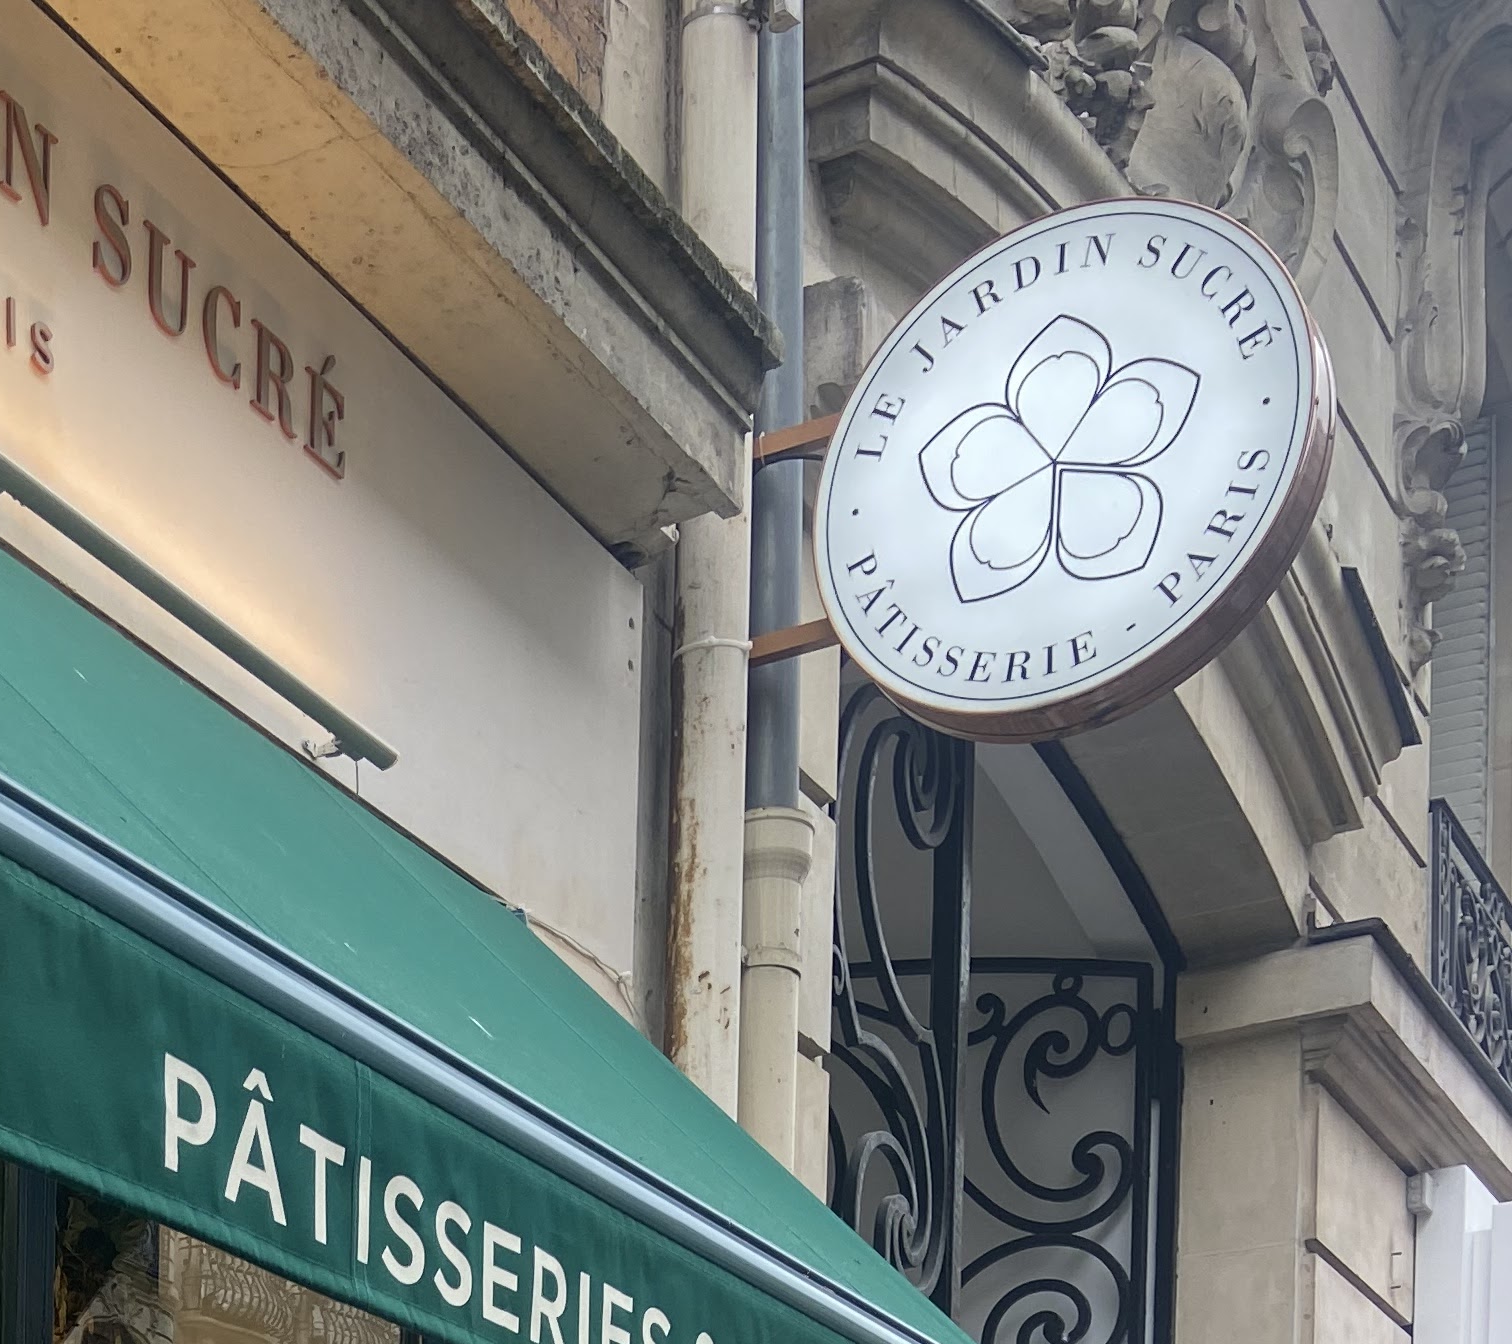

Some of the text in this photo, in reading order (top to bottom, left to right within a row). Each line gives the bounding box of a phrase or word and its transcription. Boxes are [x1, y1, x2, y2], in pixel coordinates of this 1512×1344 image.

[92, 184, 346, 480] SUCRÉ
[855, 233, 1284, 462] LE JARDIN SUCRÉ
[846, 549, 1099, 684] PÂTISSERIE
[1152, 446, 1272, 608] PARIS
